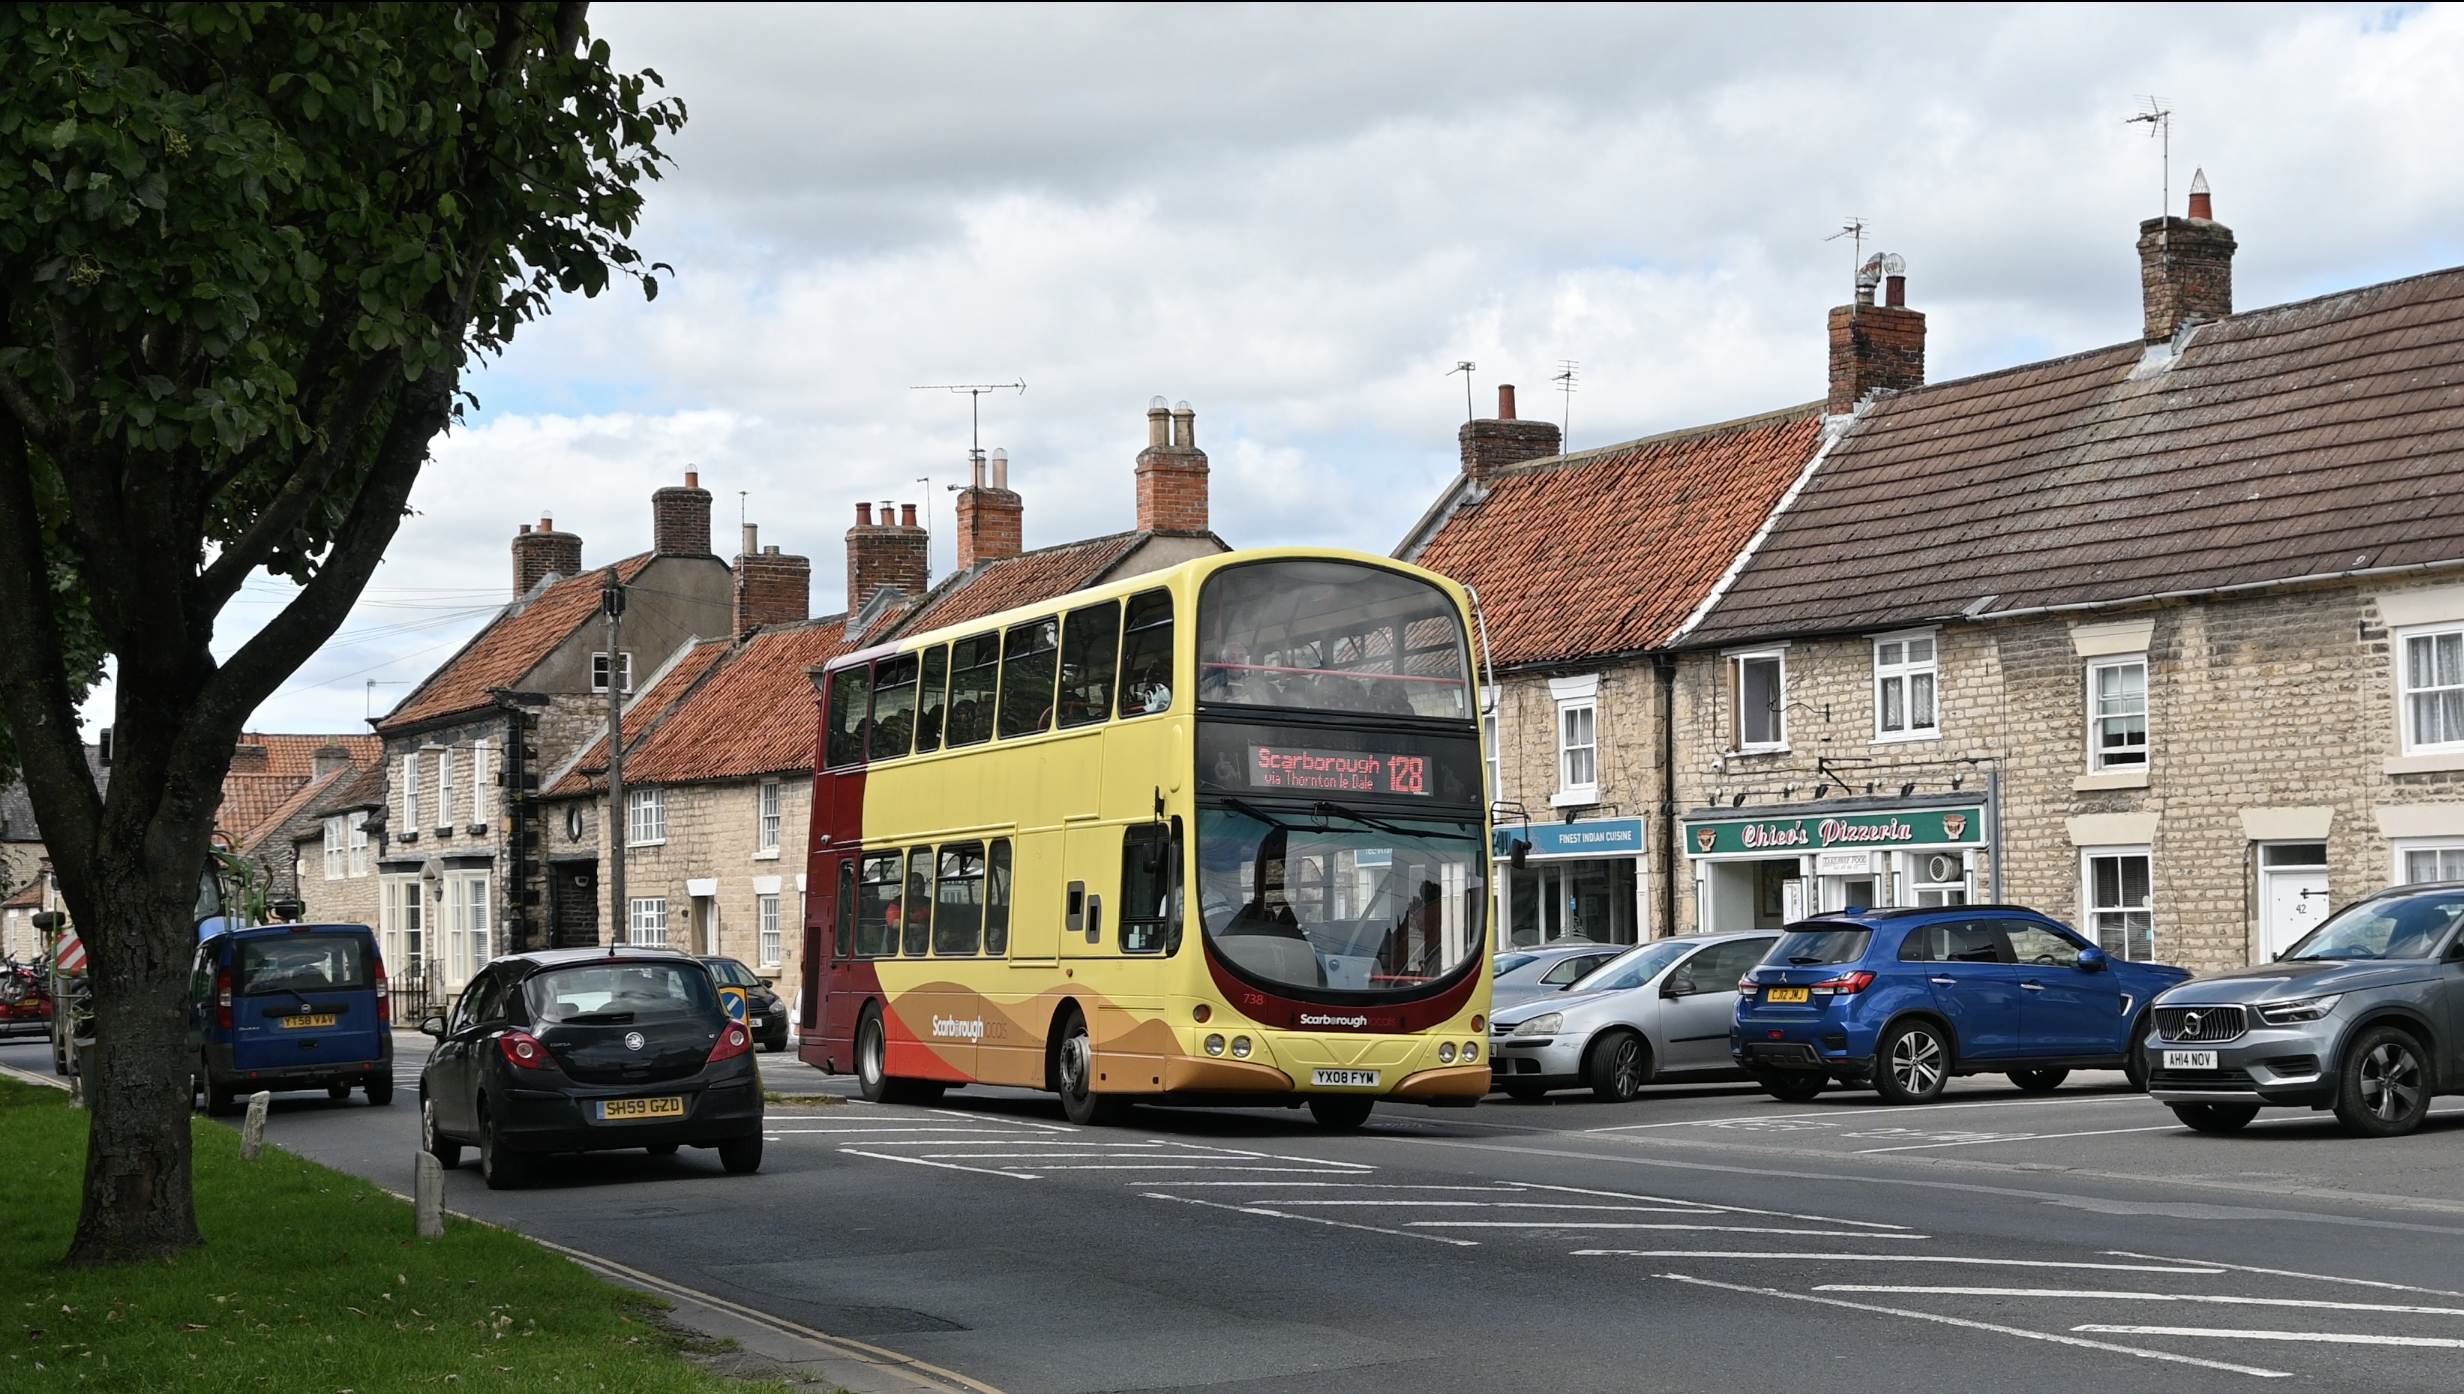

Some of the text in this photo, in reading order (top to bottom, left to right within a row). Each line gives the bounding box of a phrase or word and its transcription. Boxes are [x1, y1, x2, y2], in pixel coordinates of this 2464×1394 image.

[1258, 748, 1381, 774] Scarborough
[1264, 770, 1375, 790] via Thornton le Dale
[1387, 755, 1424, 792] 128
[1559, 830, 1632, 844] FINEST INDIAN CUISINE
[1742, 818, 1912, 848] Chico's Pizzeria
[2295, 903, 2307, 914] 42
[1243, 994, 1264, 1005] 738
[284, 1014, 334, 1026] YT58 VAV
[1300, 1013, 1367, 1028] Scarborough
[932, 1014, 984, 1044] Scarborough
[2170, 1053, 2211, 1066] AH14 NOV
[1317, 1070, 1348, 1083] YX08
[606, 1098, 680, 1115] SH59 GZD
